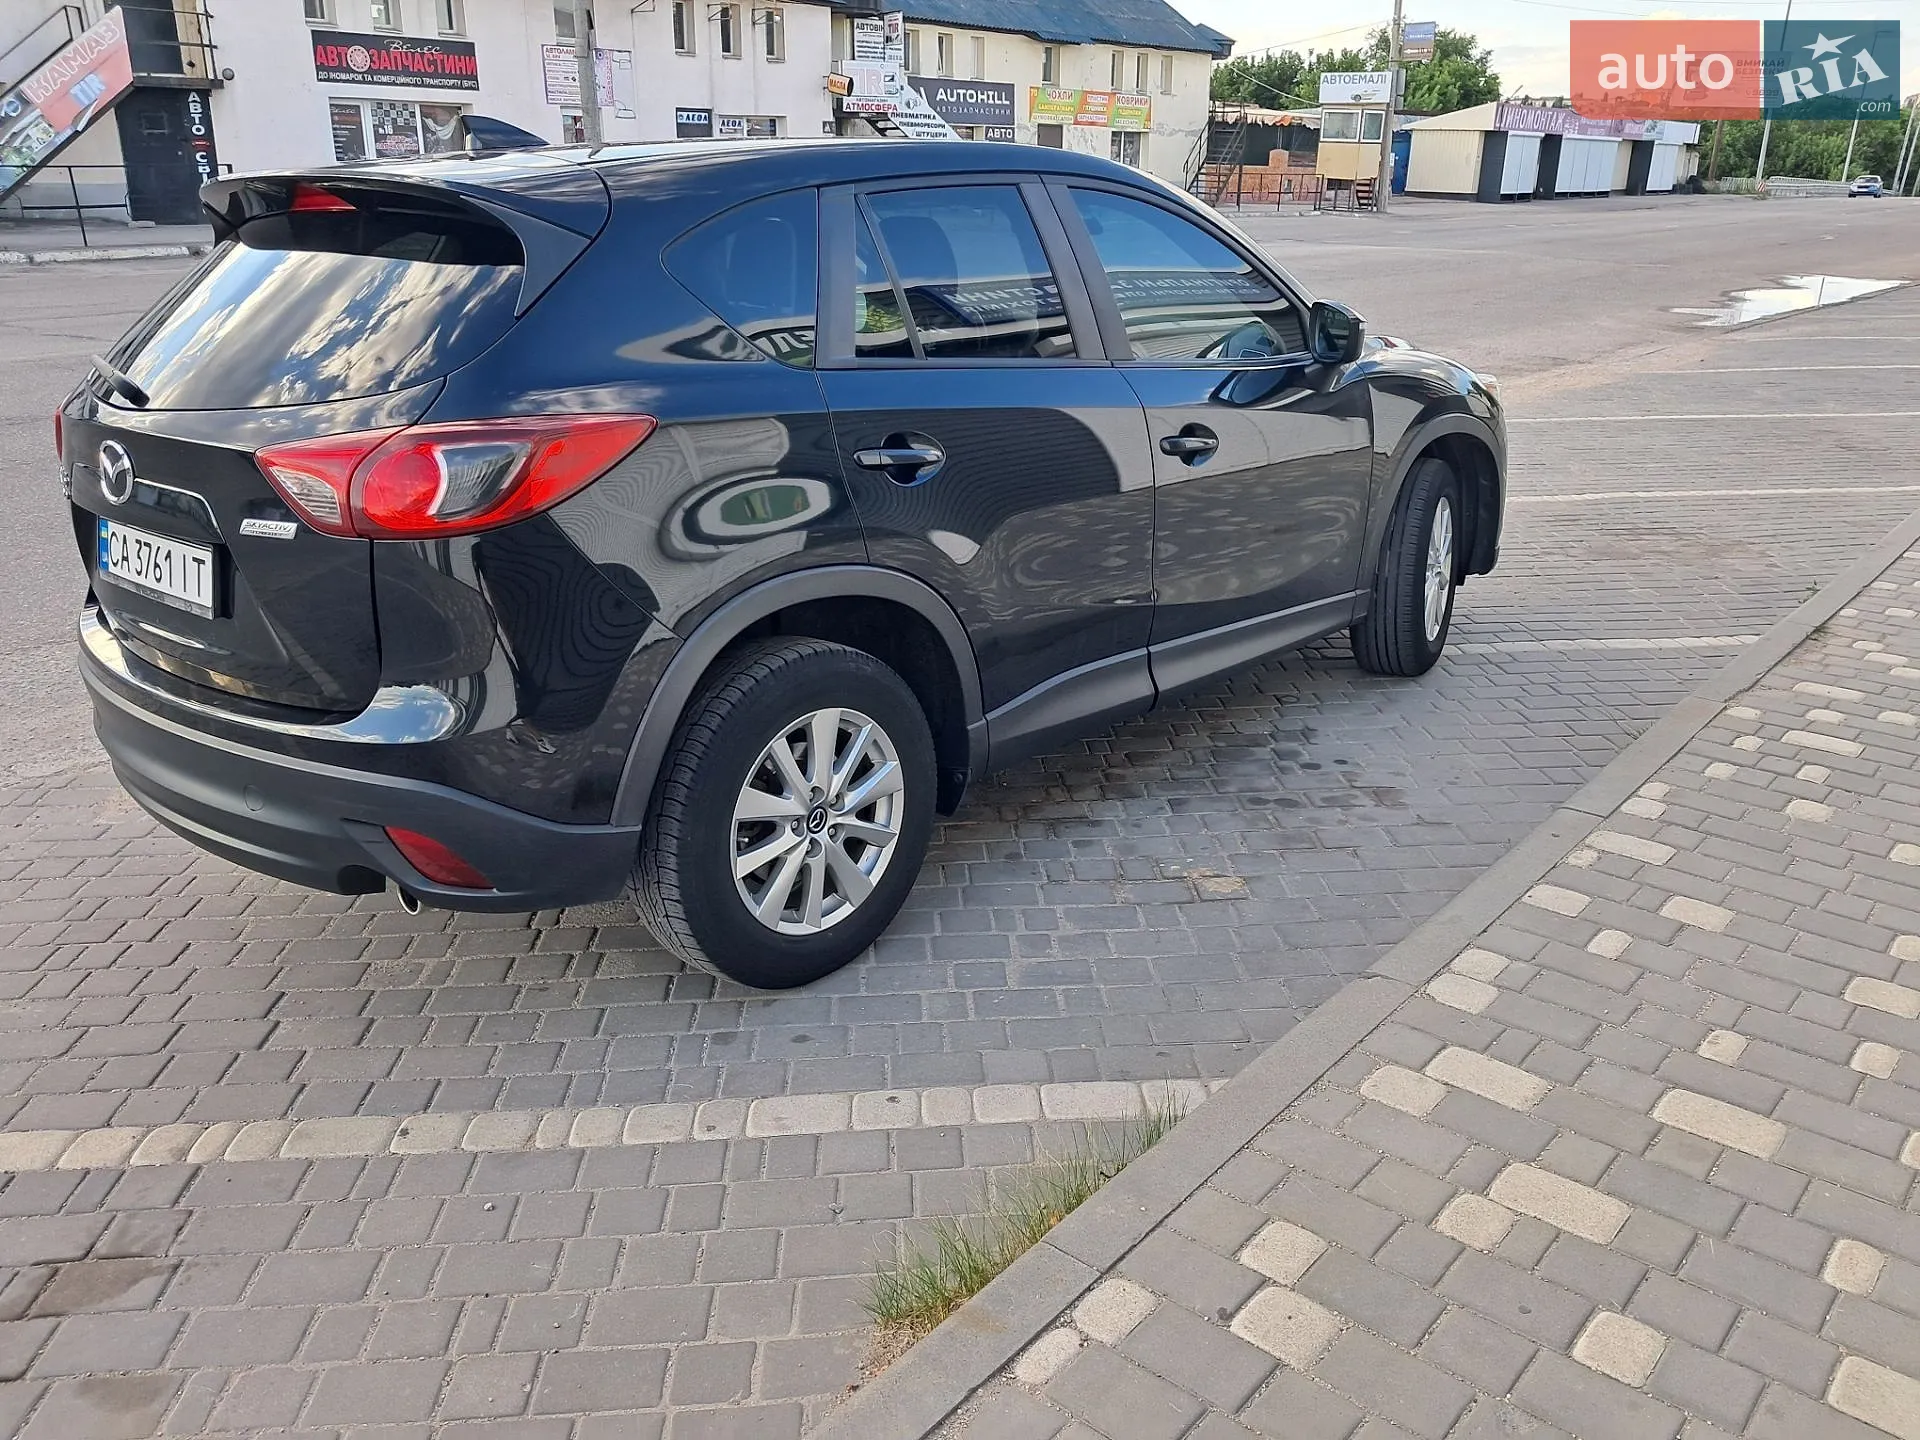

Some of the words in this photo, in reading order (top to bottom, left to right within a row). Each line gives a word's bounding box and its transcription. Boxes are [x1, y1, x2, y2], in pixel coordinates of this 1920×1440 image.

[363, 74, 372, 82] ТА
[1321, 74, 1387, 85] АВТОЕМАЛІ
[936, 87, 1010, 105] AUTOHILL
[844, 102, 898, 112] АТМОСФЕРА
[890, 111, 937, 121] ПНЕВМАТИКА
[987, 128, 1013, 139] АВТО
[195, 151, 211, 184] СВІ
[110, 531, 130, 573] CA
[134, 539, 172, 588] 3761
[183, 554, 206, 598] IT
